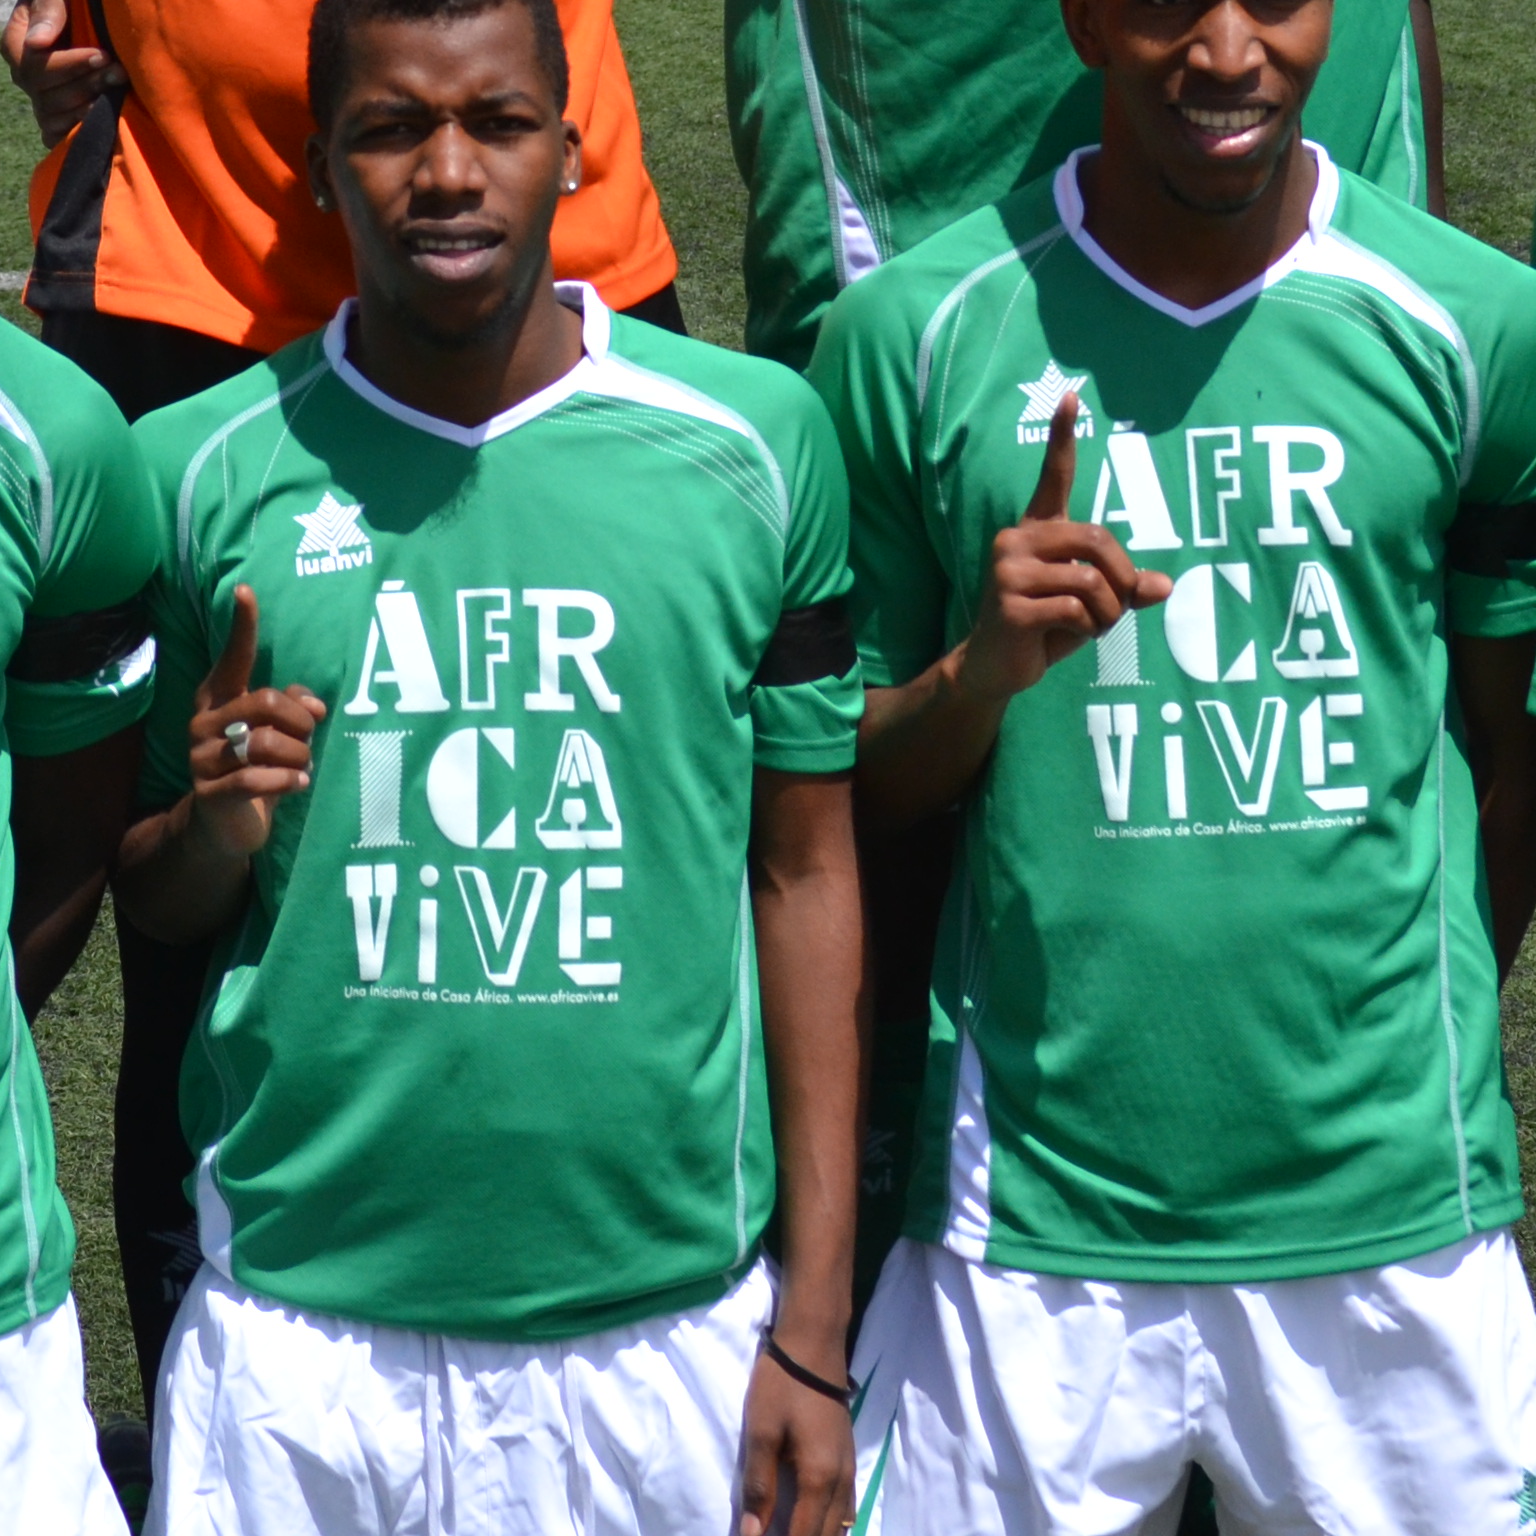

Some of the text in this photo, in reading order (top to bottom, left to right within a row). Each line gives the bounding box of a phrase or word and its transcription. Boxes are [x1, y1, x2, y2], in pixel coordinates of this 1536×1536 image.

[1017, 417, 1094, 444] luavi
[1089, 420, 1353, 551] ÁFR
[295, 546, 373, 577] luanvi
[343, 580, 621, 715] ÁFR
[344, 727, 622, 850] ICA
[1086, 694, 1368, 822] ViVE
[1094, 826, 1116, 838] Una
[1119, 824, 1172, 838] iniciativa
[1175, 822, 1190, 836] de
[1193, 822, 1224, 836] Casa
[345, 863, 624, 986] ViVE
[344, 985, 619, 1004] Una iniciativa de Casa África. www.africavive.es
